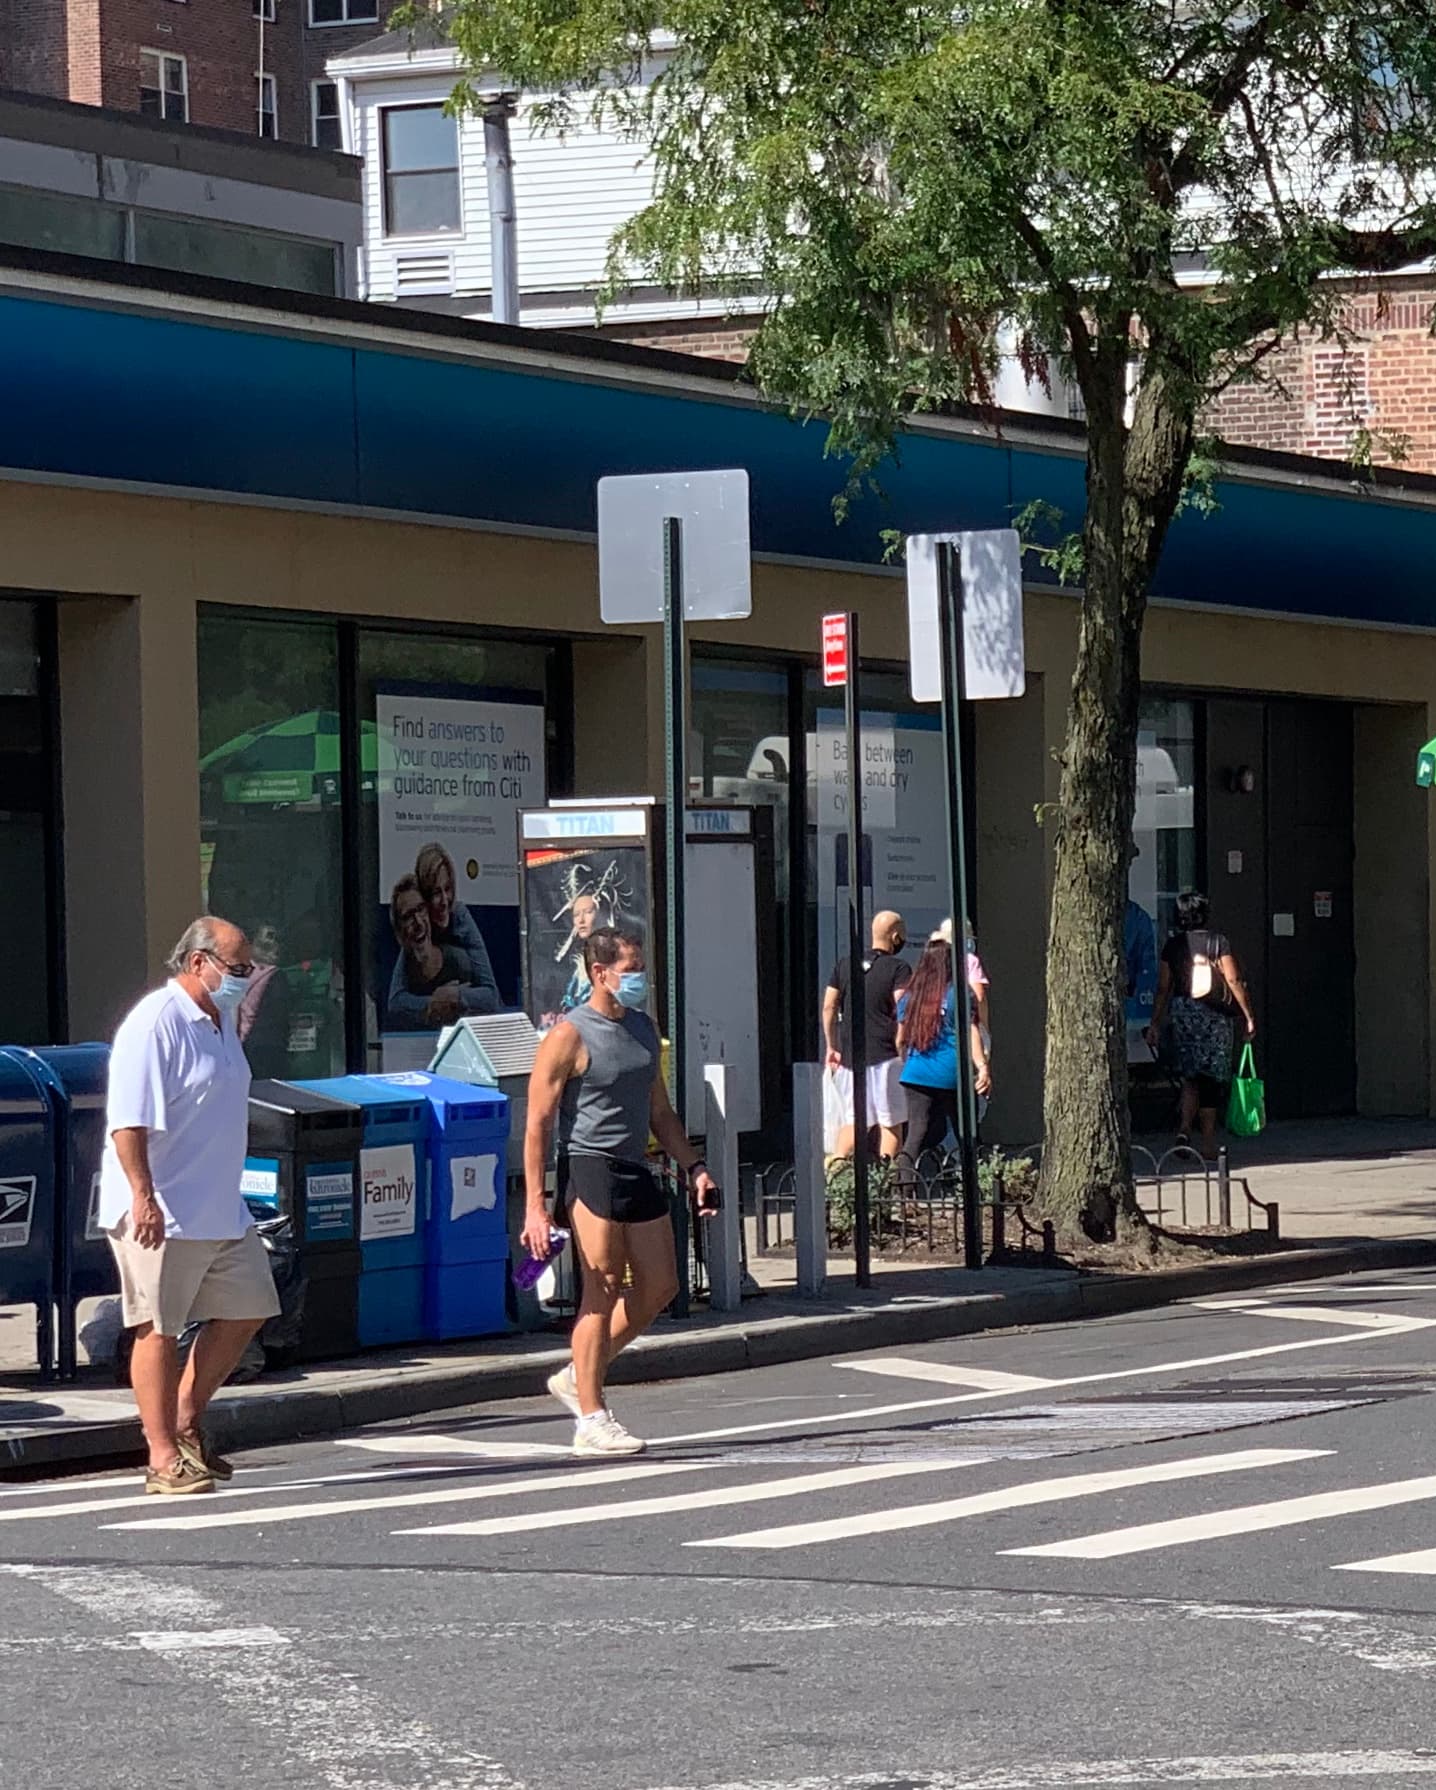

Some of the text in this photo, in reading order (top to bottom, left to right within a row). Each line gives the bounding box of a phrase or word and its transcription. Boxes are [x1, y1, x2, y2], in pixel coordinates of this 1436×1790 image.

[393, 715, 505, 744] Find answers to
[393, 748, 531, 773] your questions with
[865, 742, 913, 765] between
[393, 772, 522, 800] guidance from Citi
[865, 768, 888, 787] and
[889, 769, 909, 792] dry
[556, 814, 615, 835] TITAN
[691, 812, 730, 832] TITAN
[364, 1176, 414, 1206] Family
